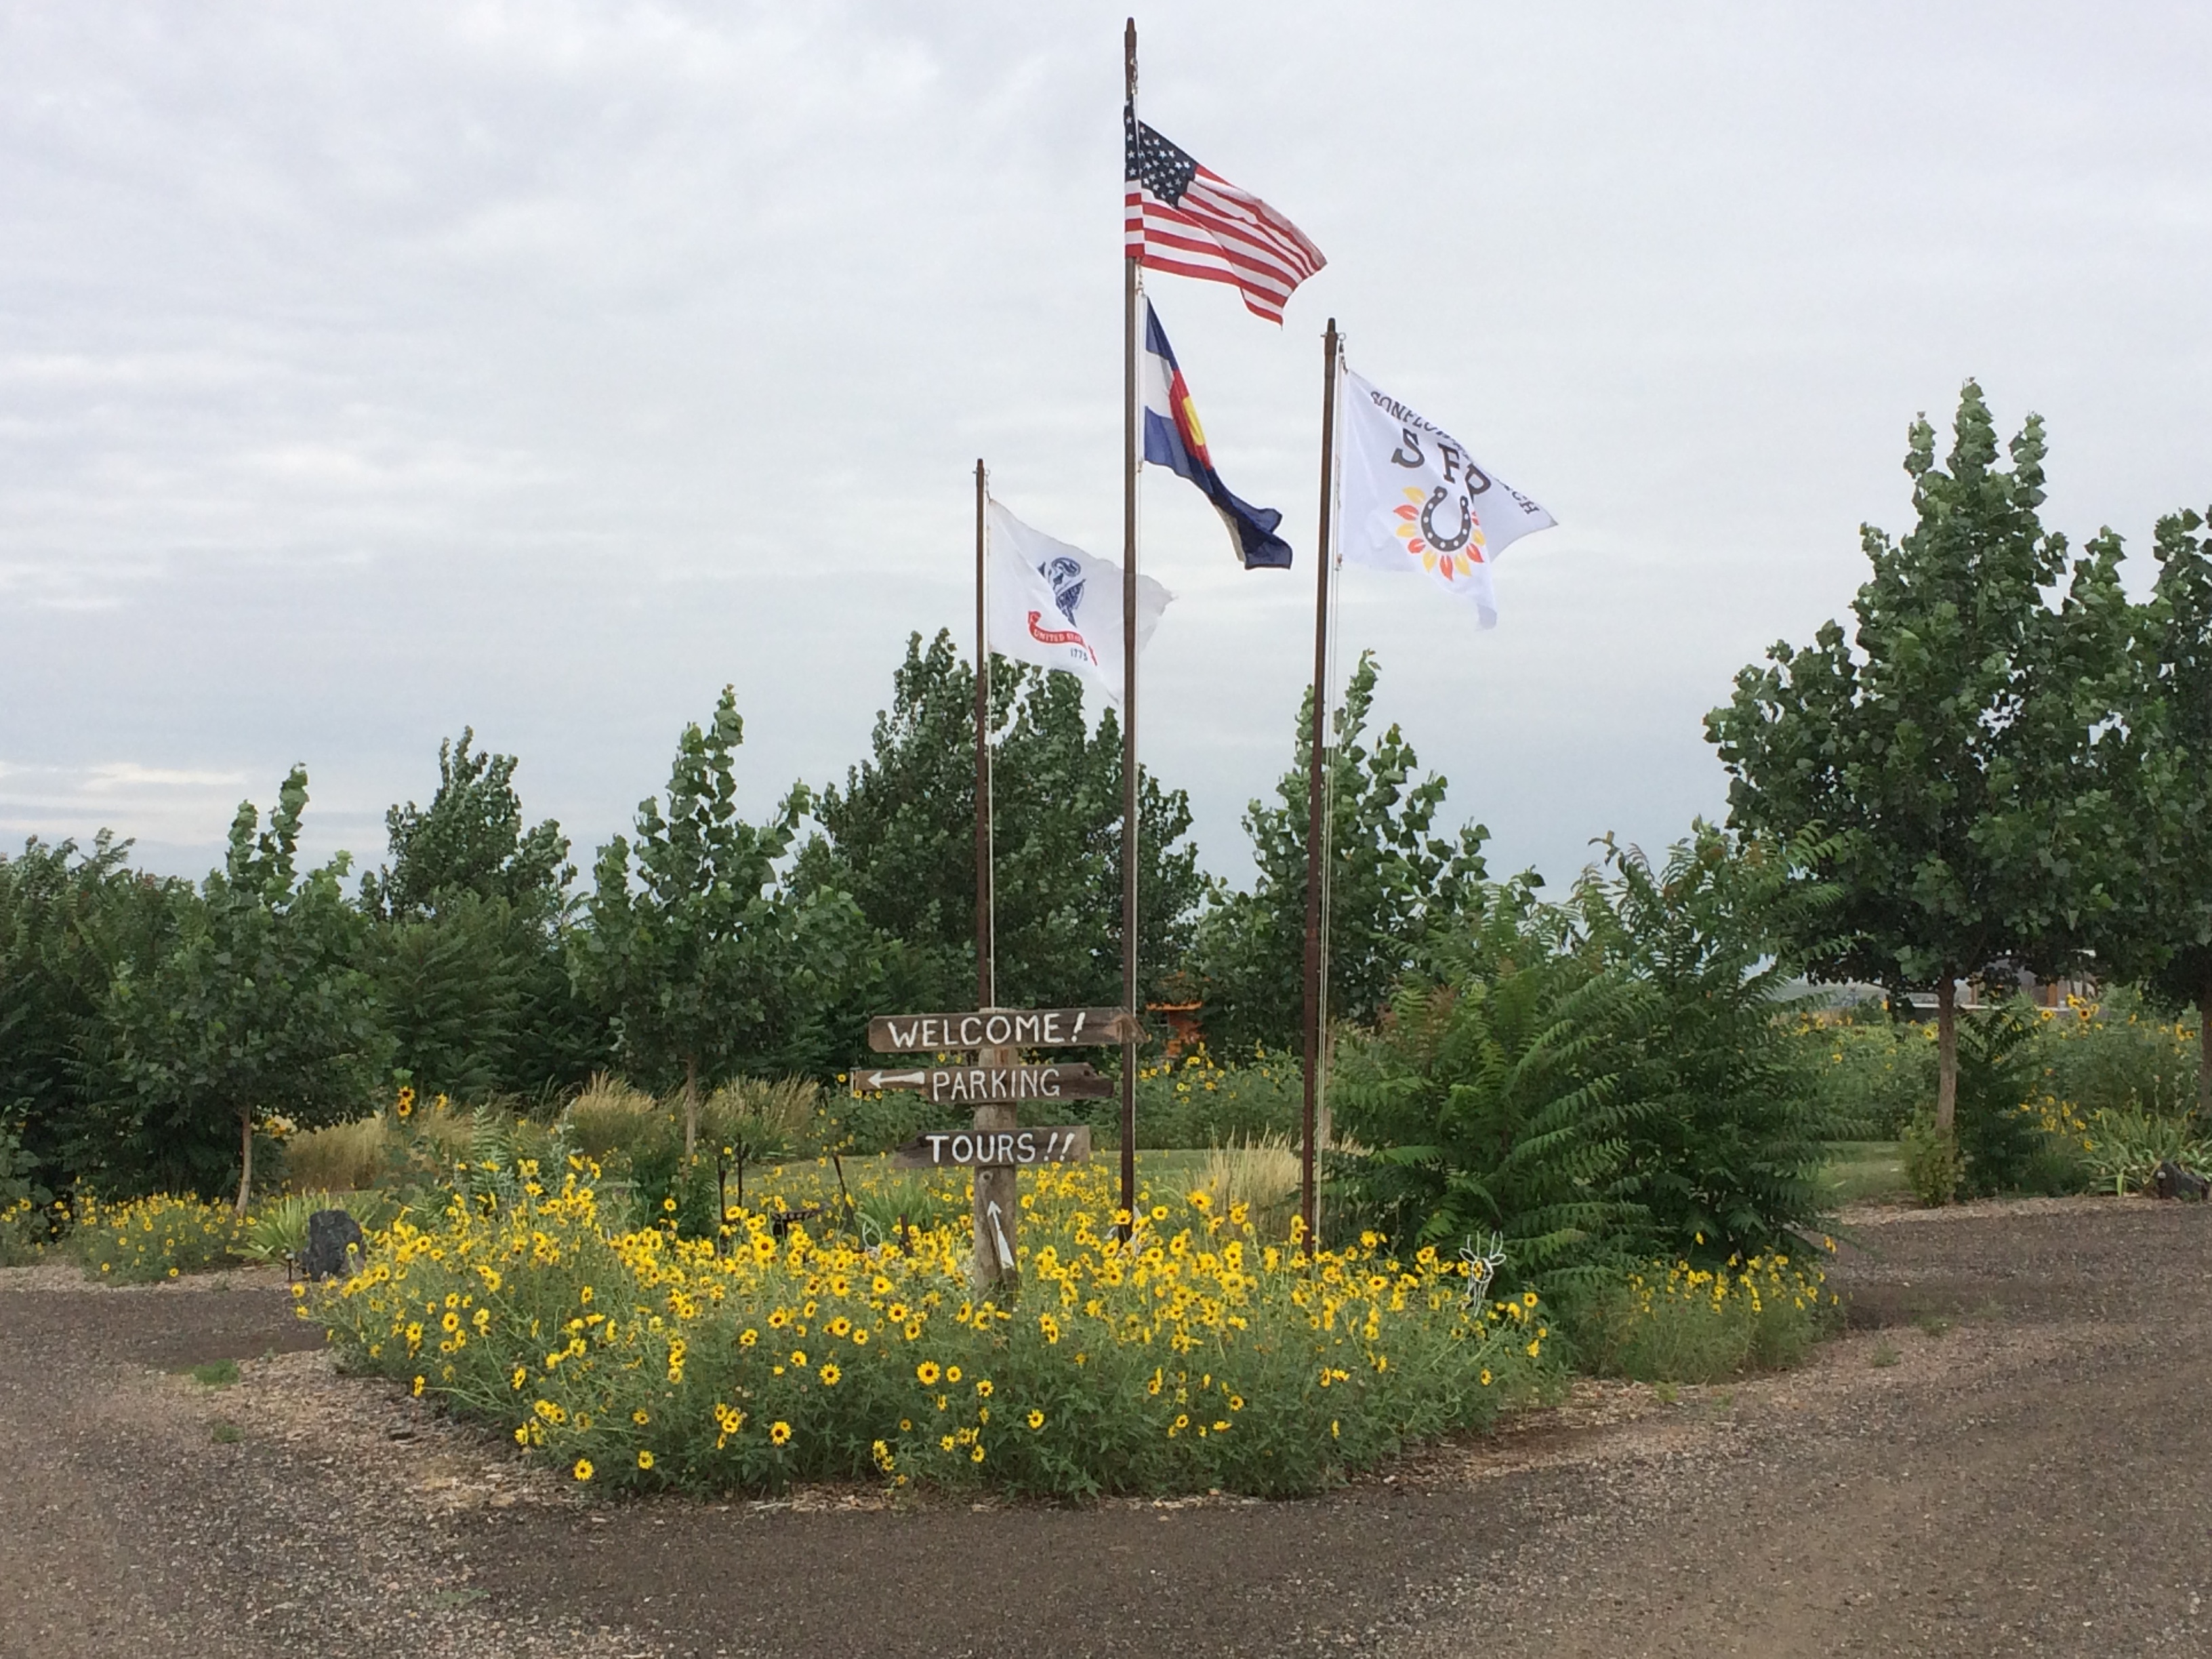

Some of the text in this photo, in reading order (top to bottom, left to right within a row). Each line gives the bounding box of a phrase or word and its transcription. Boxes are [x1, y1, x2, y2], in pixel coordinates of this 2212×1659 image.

[1033, 628, 1065, 642] UNITED
[887, 1012, 1086, 1048] WELCOME!
[932, 1068, 1060, 1102] PARKING
[925, 1132, 1075, 1163] TOURS!!
